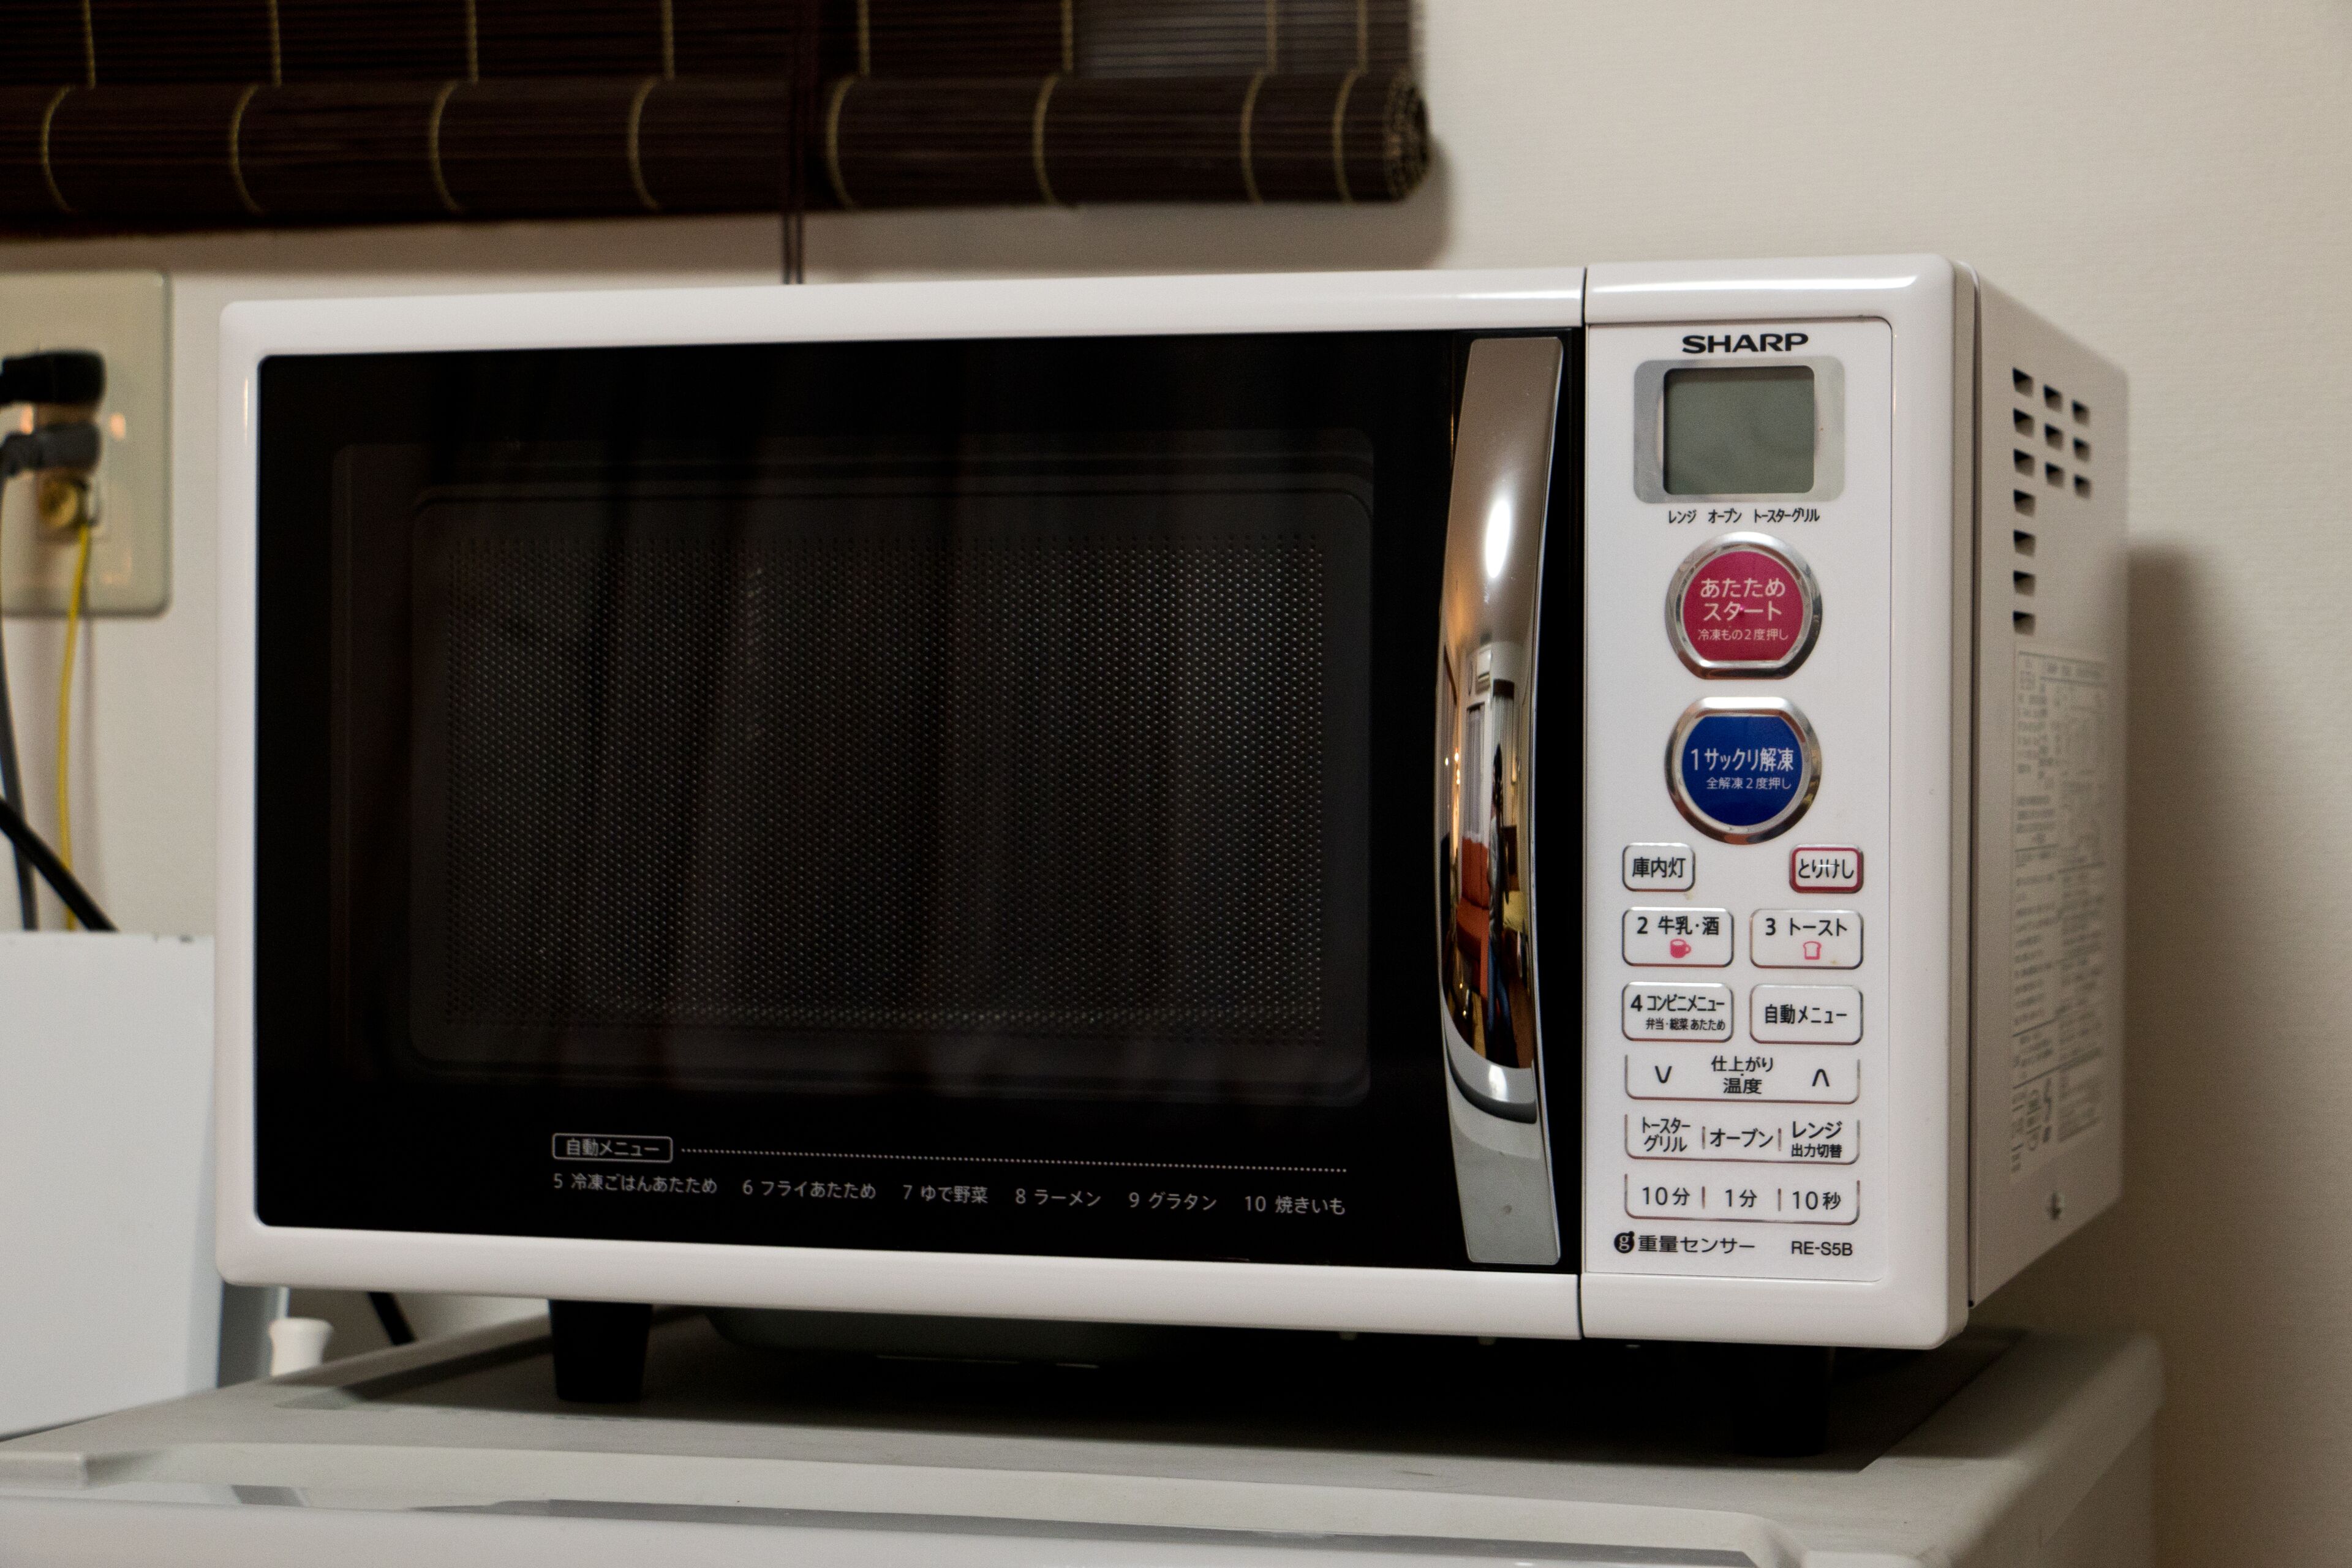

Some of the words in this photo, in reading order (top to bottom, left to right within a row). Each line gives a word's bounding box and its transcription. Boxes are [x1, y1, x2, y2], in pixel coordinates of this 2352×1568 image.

[1682, 333, 1809, 354] SHARP
[1668, 509, 1697, 524] レンジ
[1708, 507, 1743, 524] オーブン
[1754, 507, 1820, 524] トースターグリル
[1700, 578, 1786, 598] あたため
[1703, 600, 1782, 622] スタート
[1632, 856, 1686, 878] 庫内灯
[1798, 858, 1855, 880] とりけし
[1637, 916, 1648, 935] 2
[1765, 917, 1776, 937] 3
[1789, 917, 1848, 937] トースト
[1765, 1003, 1847, 1025] 自動メニュー
[1723, 1077, 1762, 1095] 温度
[1642, 1117, 1691, 1134] トースター
[1792, 1120, 1842, 1140] レンジ
[567, 1138, 660, 1158] 自動メニュー
[1643, 1134, 1687, 1153] グリル
[1709, 1128, 1774, 1148] オーブン
[1791, 1143, 1842, 1158] 出力切替
[553, 1172, 564, 1189] 5
[571, 1172, 717, 1194] 冷凍ごはんあたため
[742, 1179, 753, 1196] 6
[761, 1180, 876, 1199] フライあたため
[903, 1184, 913, 1200] 7
[921, 1185, 988, 1204] ゆで野菜
[1015, 1188, 1027, 1205] 8
[1034, 1189, 1101, 1207] ラーメン
[1128, 1191, 1140, 1208] 9
[1148, 1191, 1217, 1211] グラタン
[1245, 1195, 1267, 1212] 10
[1275, 1195, 1346, 1215] 焼きいも
[1638, 1235, 1755, 1254] 重量センサー
[1791, 1240, 1853, 1257] RE-S5B
